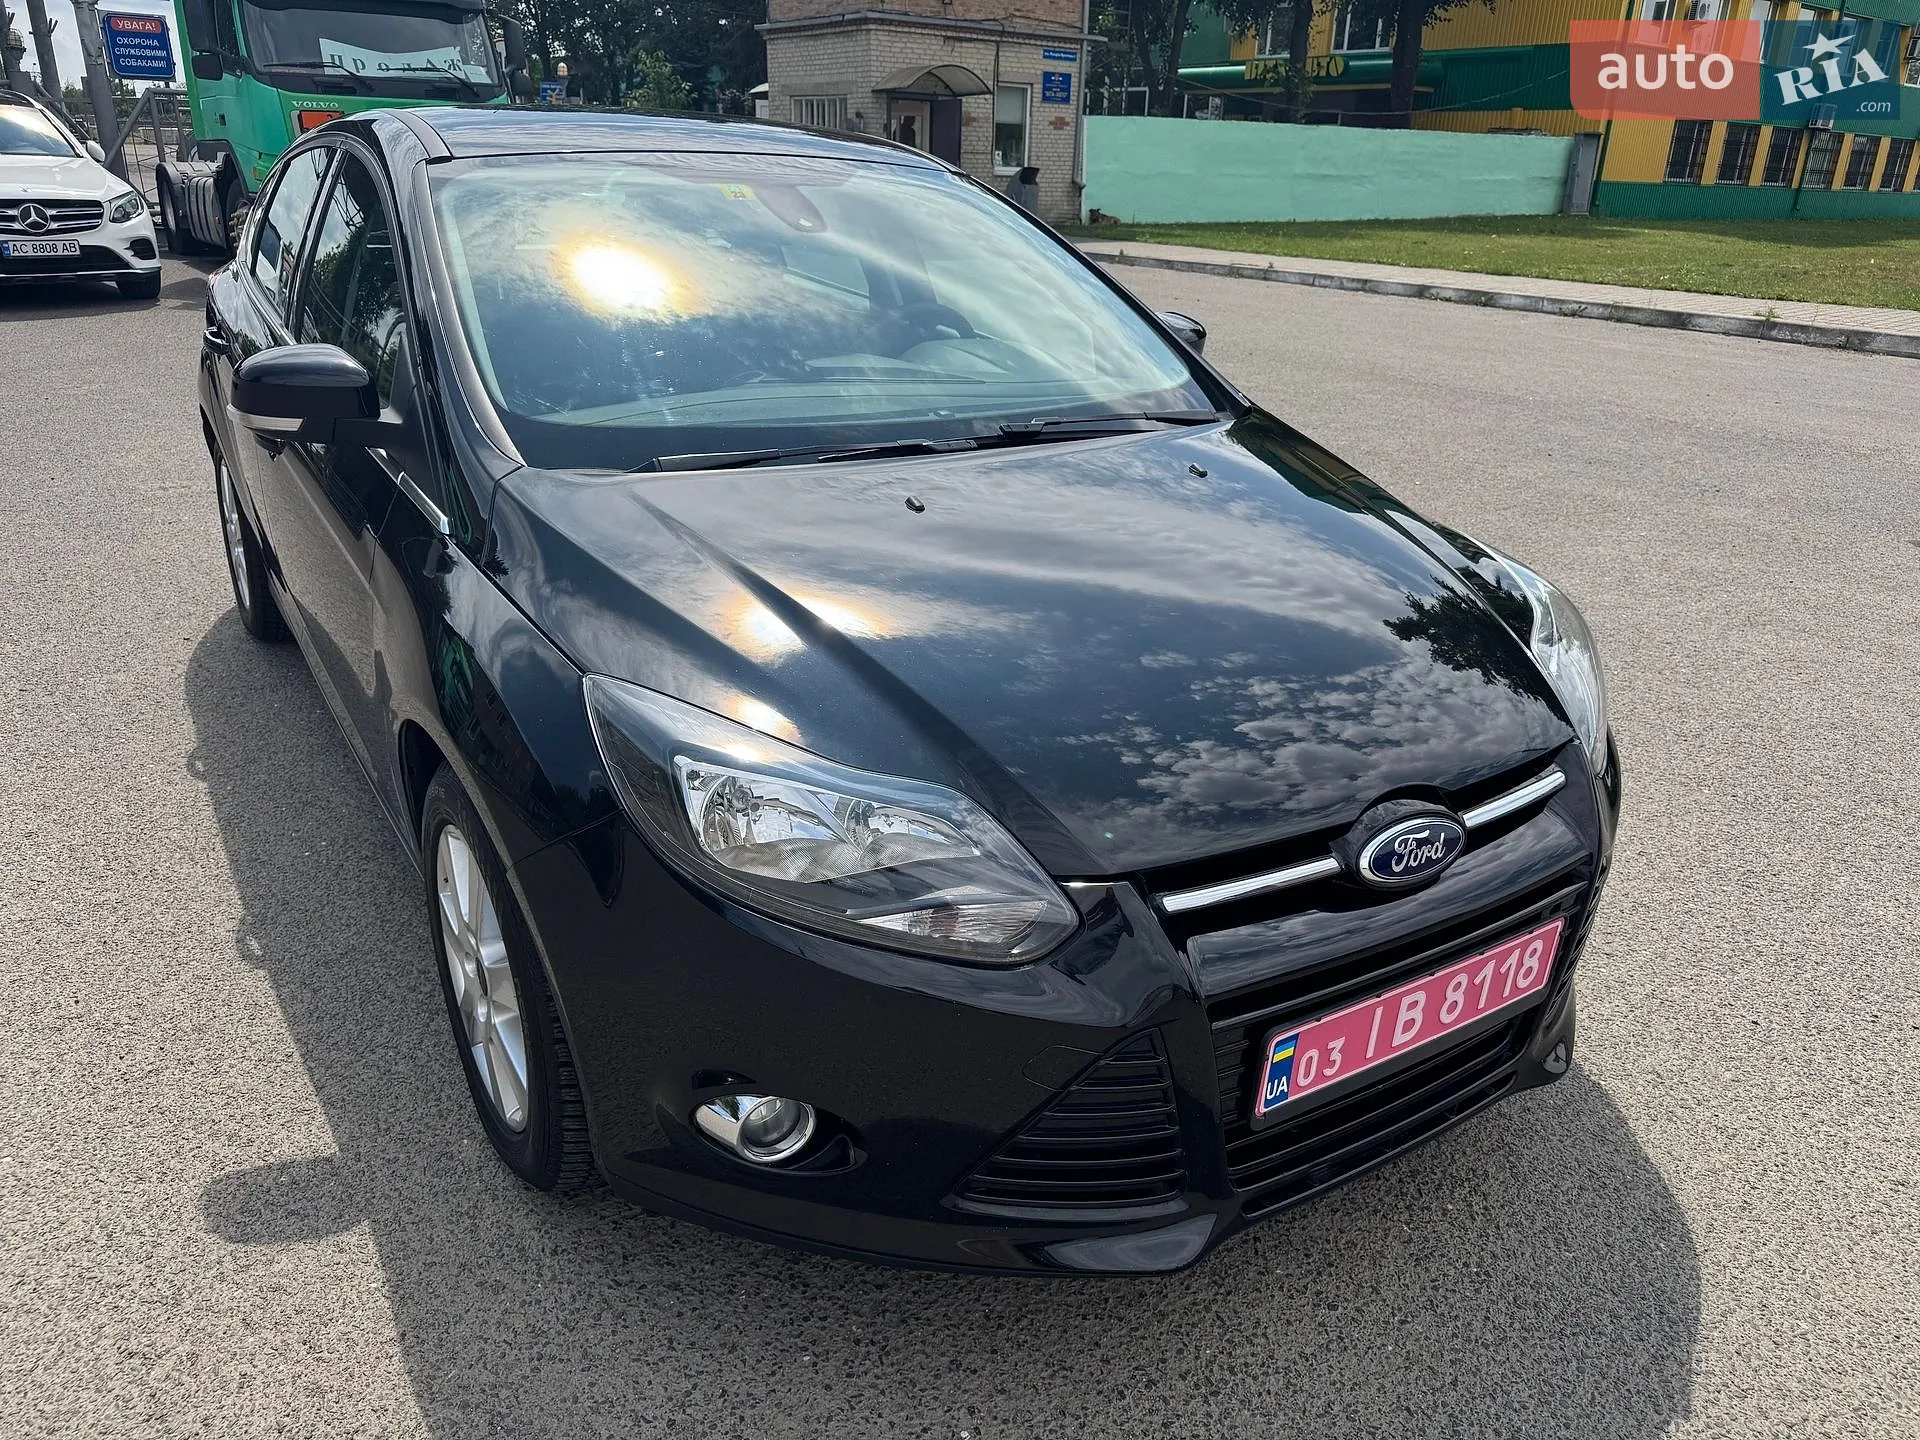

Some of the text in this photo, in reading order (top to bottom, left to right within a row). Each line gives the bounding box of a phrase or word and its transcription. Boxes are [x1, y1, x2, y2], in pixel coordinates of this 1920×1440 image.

[117, 19, 156, 31] УВАГА!
[116, 36, 160, 47] ОХОРОНА
[114, 47, 167, 58] СЛУЖБОВИМИ
[119, 58, 167, 68] СОБАКАМИ!
[291, 101, 339, 109] VOLVO
[12, 242, 78, 254] AC 8808 AB
[1391, 829, 1447, 873] Ford
[1296, 939, 1545, 1088] 03 IB 8118
[1266, 1075, 1289, 1100] UA
